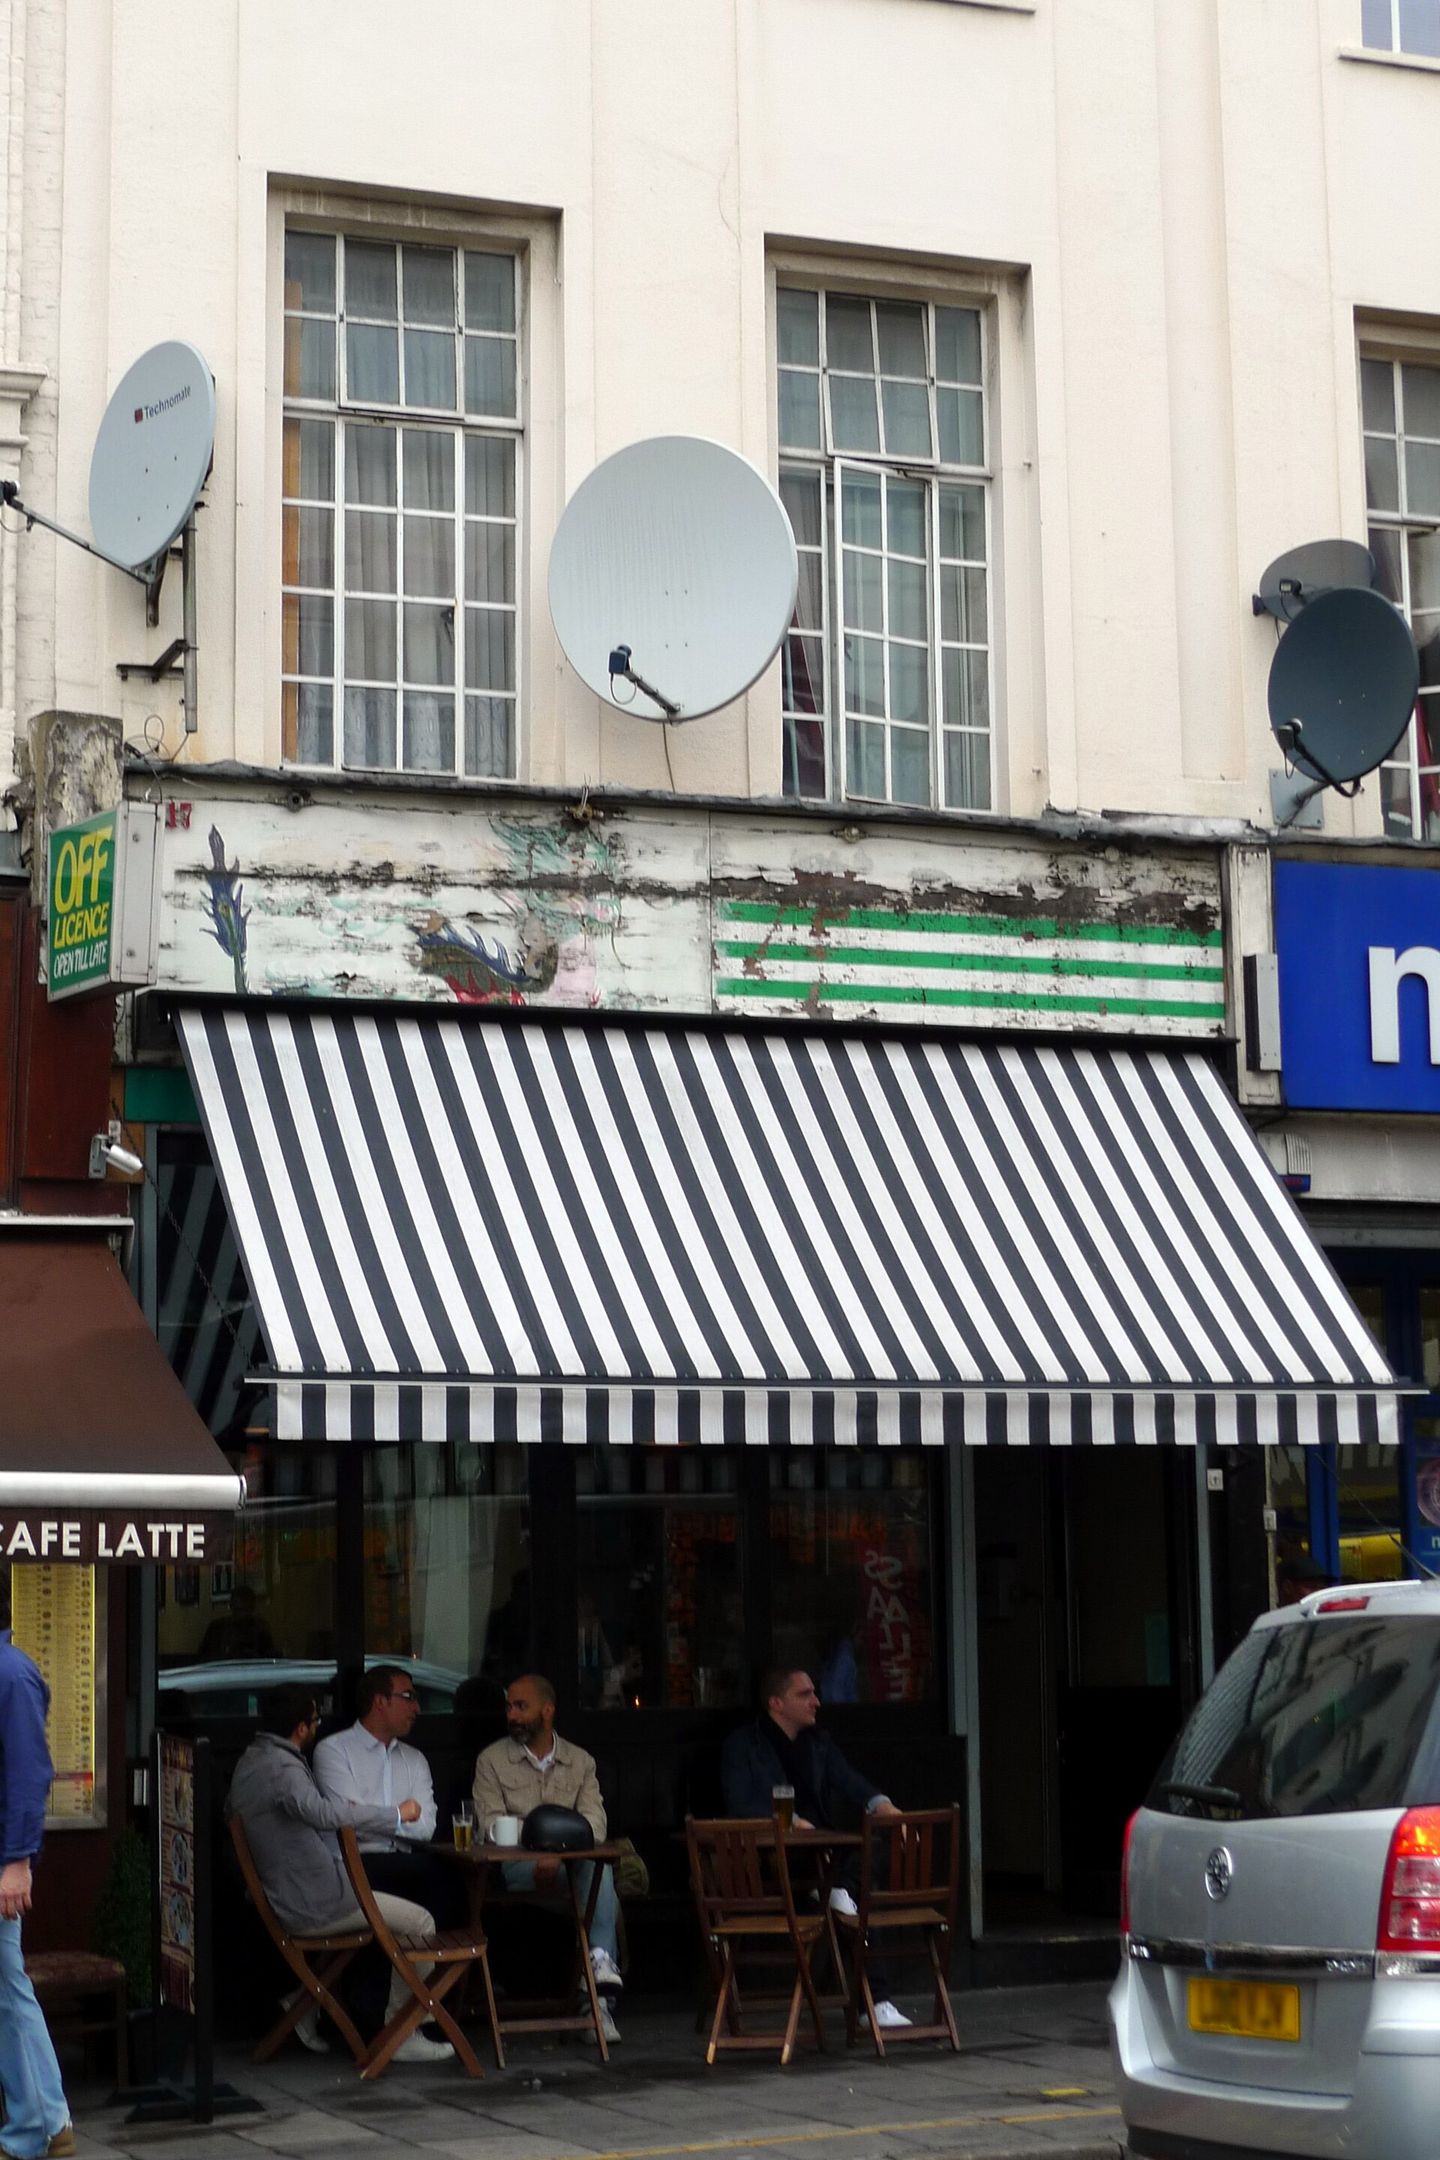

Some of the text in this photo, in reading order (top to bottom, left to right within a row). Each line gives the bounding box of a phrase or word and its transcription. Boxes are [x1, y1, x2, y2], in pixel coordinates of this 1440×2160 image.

[145, 386, 191, 419] Technomate
[55, 827, 113, 914] OFF
[53, 902, 110, 949] LICENCE
[53, 939, 108, 979] OPEN TILL LATE
[0, 1520, 206, 1559] AFE LATTE
